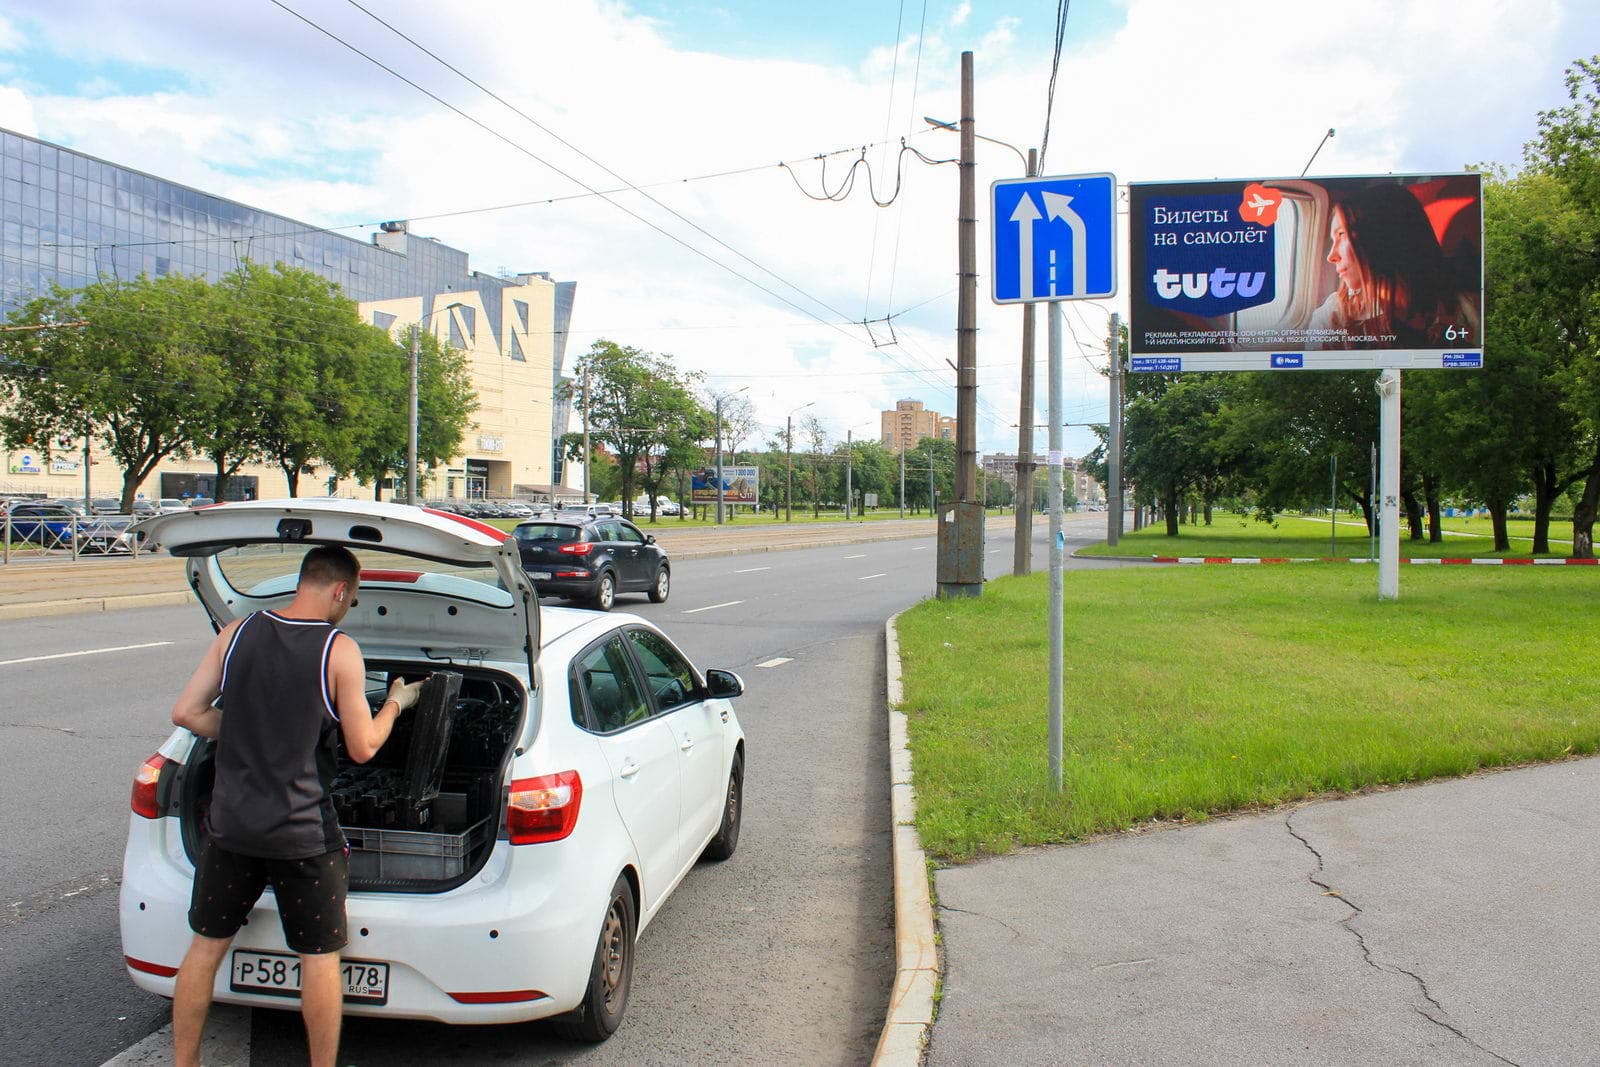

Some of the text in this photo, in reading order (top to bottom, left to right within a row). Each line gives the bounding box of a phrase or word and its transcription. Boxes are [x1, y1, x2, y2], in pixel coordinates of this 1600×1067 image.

[1153, 207, 1228, 225] Билеты
[1153, 227, 1267, 246] на самолёт
[1153, 267, 1266, 299] tutu
[1445, 325, 1468, 341] 6+
[342, 965, 379, 987] 178
[348, 985, 368, 994] RUS
